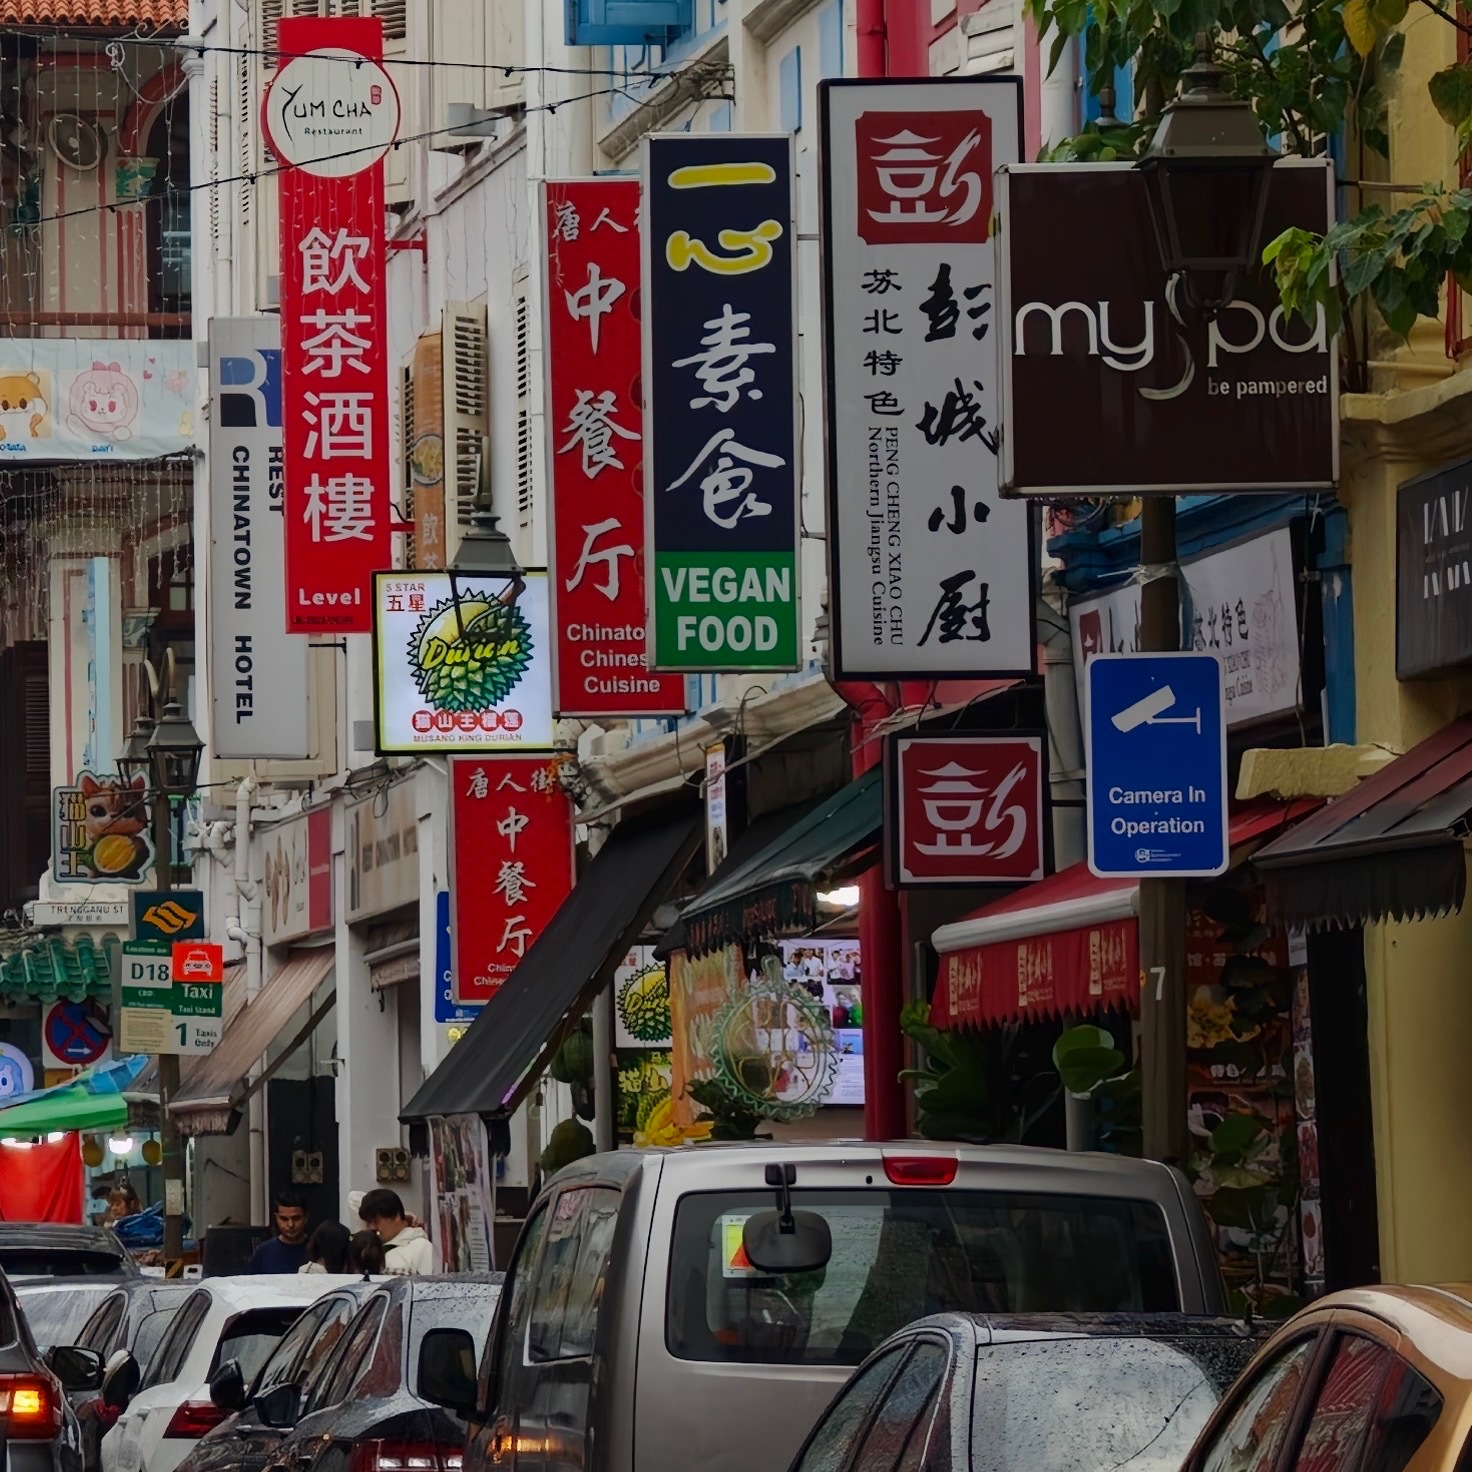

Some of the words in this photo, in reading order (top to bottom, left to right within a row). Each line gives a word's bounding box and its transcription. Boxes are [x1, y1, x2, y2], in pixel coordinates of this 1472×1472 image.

[304, 126, 363, 136] Restaurant
[555, 199, 642, 241] 唐人
[861, 268, 906, 419] 苏北特色
[299, 226, 375, 544] 飲茶酒樓
[1207, 376, 1229, 395] be
[1236, 375, 1328, 399] pampered
[558, 262, 642, 602] 中餐厅
[884, 426, 901, 475] PENG
[867, 426, 884, 506] Northern
[231, 445, 252, 610] CHINATOWN
[886, 487, 902, 547] CHENG
[866, 510, 886, 575] Jiangsu
[661, 566, 790, 603] VEGAN
[888, 552, 902, 599] XIAO
[298, 587, 362, 606] Level
[386, 593, 426, 612] 五星
[870, 581, 887, 646] Cuisine
[675, 614, 779, 652] FOOD
[889, 605, 904, 646] CHU
[234, 635, 254, 724] HOTEL
[583, 675, 661, 695] Cuisine
[412, 734, 456, 743] MUSANG
[1108, 786, 1183, 805] Camera
[1188, 785, 1206, 803] In
[1110, 816, 1205, 838] Operation
[131, 963, 170, 982] D18
[181, 984, 214, 1000] Taxi
[1150, 966, 1167, 1002] 7
